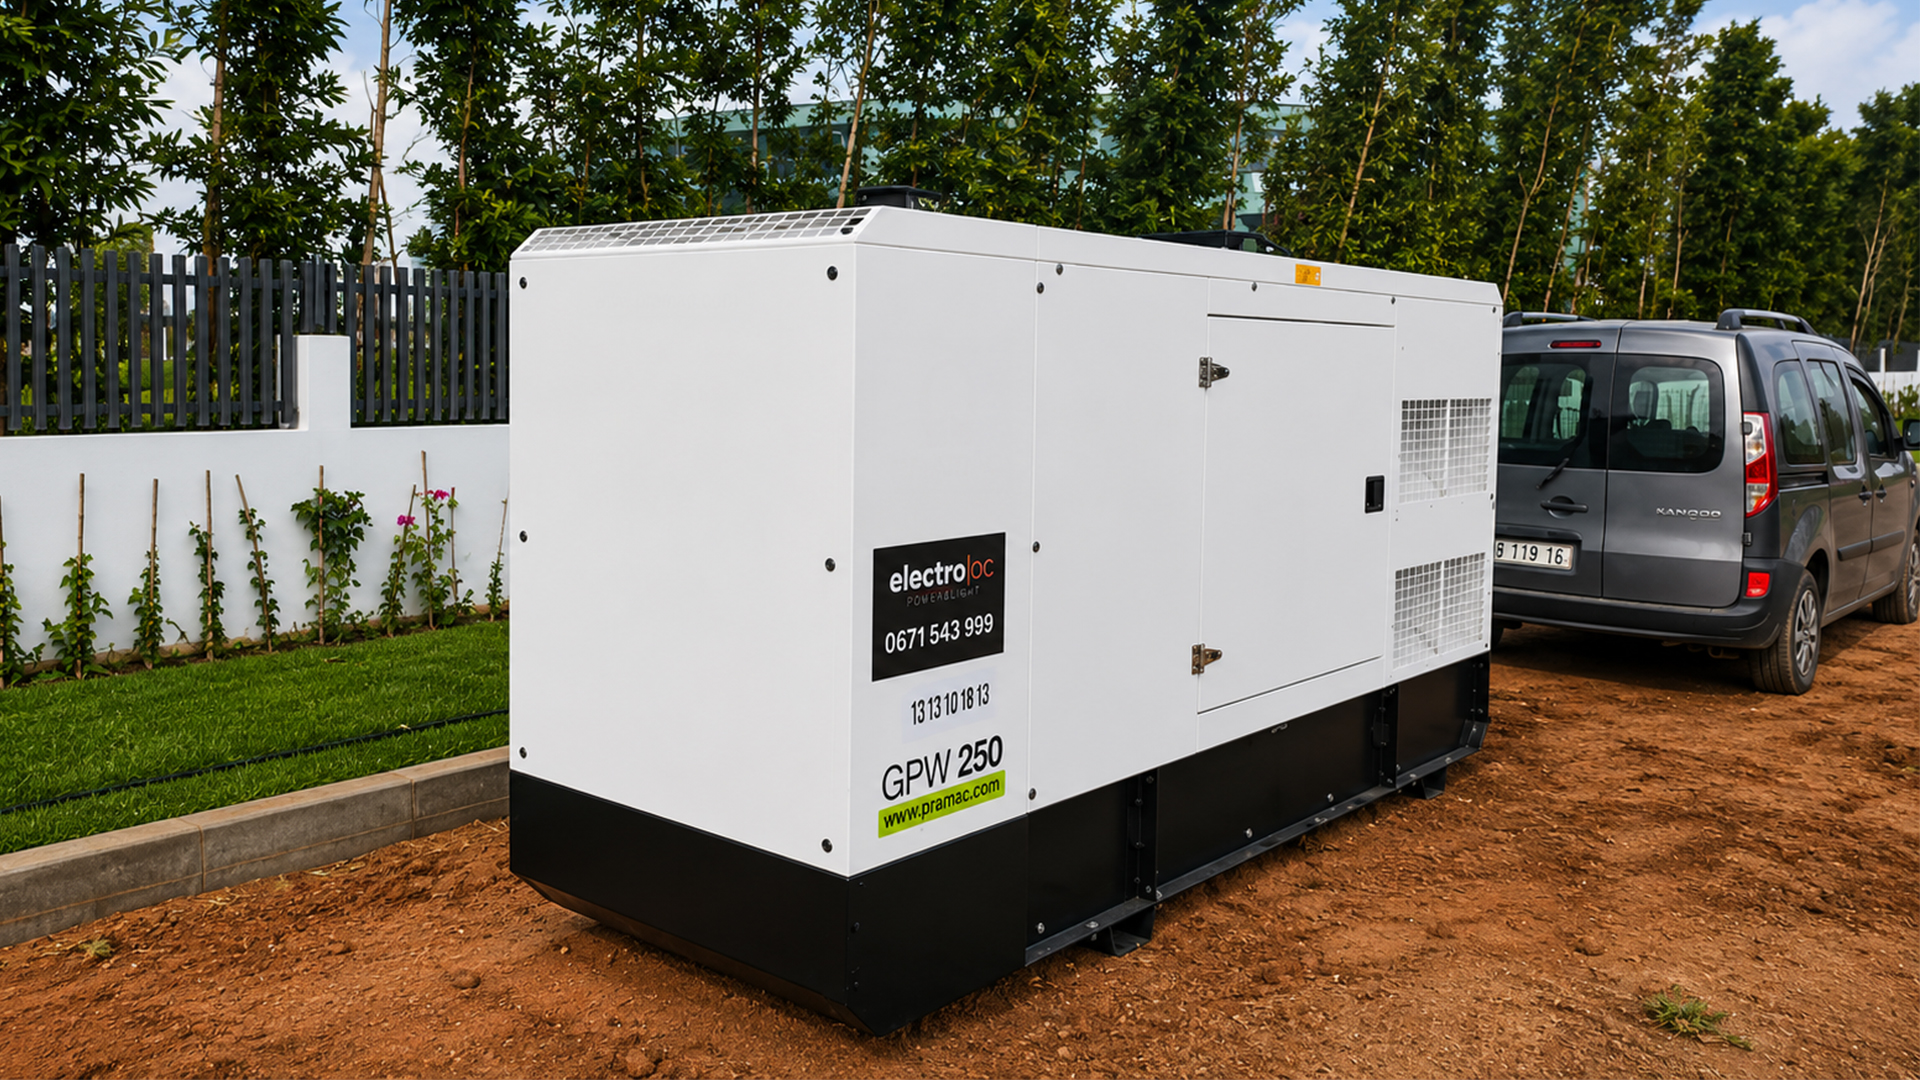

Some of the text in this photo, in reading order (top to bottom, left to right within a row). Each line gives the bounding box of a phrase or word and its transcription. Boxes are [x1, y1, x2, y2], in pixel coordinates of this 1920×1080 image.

[1656, 507, 1721, 520] KANGOO
[889, 554, 994, 593] electroloc
[1512, 543, 1539, 562] 119
[1546, 546, 1564, 565] 16
[885, 612, 994, 654] 0671 543 999
[882, 735, 1004, 801] GPW 250
[883, 778, 1000, 829] www.pramac.com
